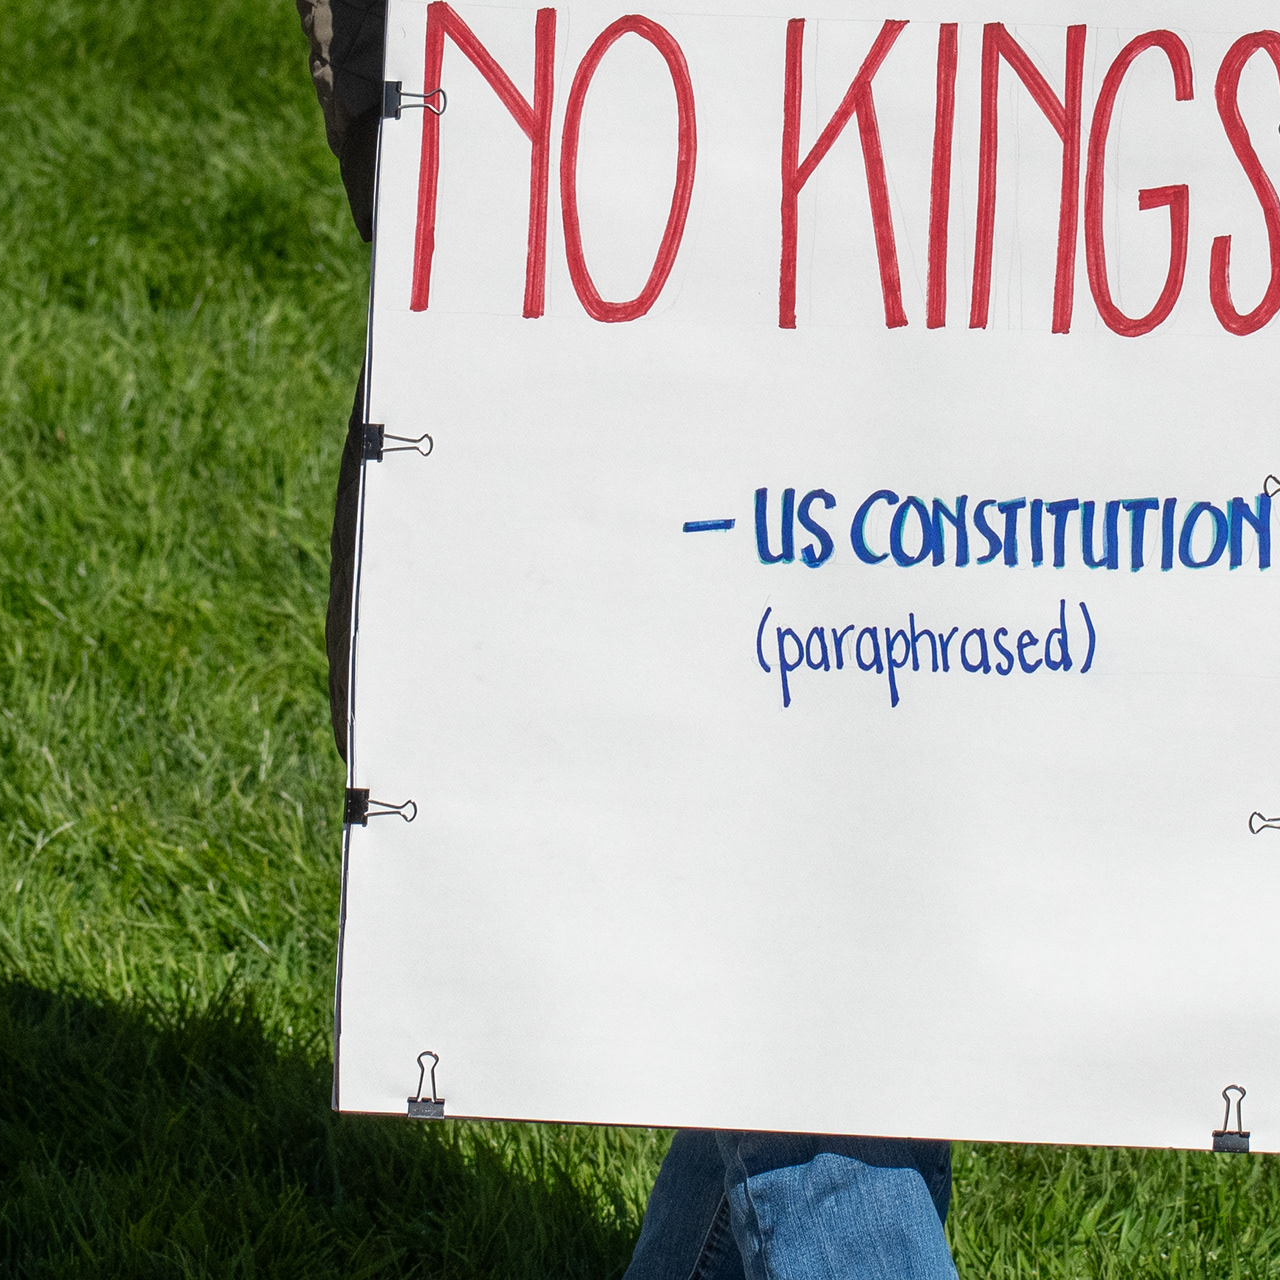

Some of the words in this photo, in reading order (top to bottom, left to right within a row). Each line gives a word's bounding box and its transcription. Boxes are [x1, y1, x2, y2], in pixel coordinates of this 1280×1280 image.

[409, 0, 698, 324] NO
[753, 487, 837, 569] US
[850, 489, 1273, 573] CONSTITUTION
[755, 598, 1097, 709] (paraphrased)
